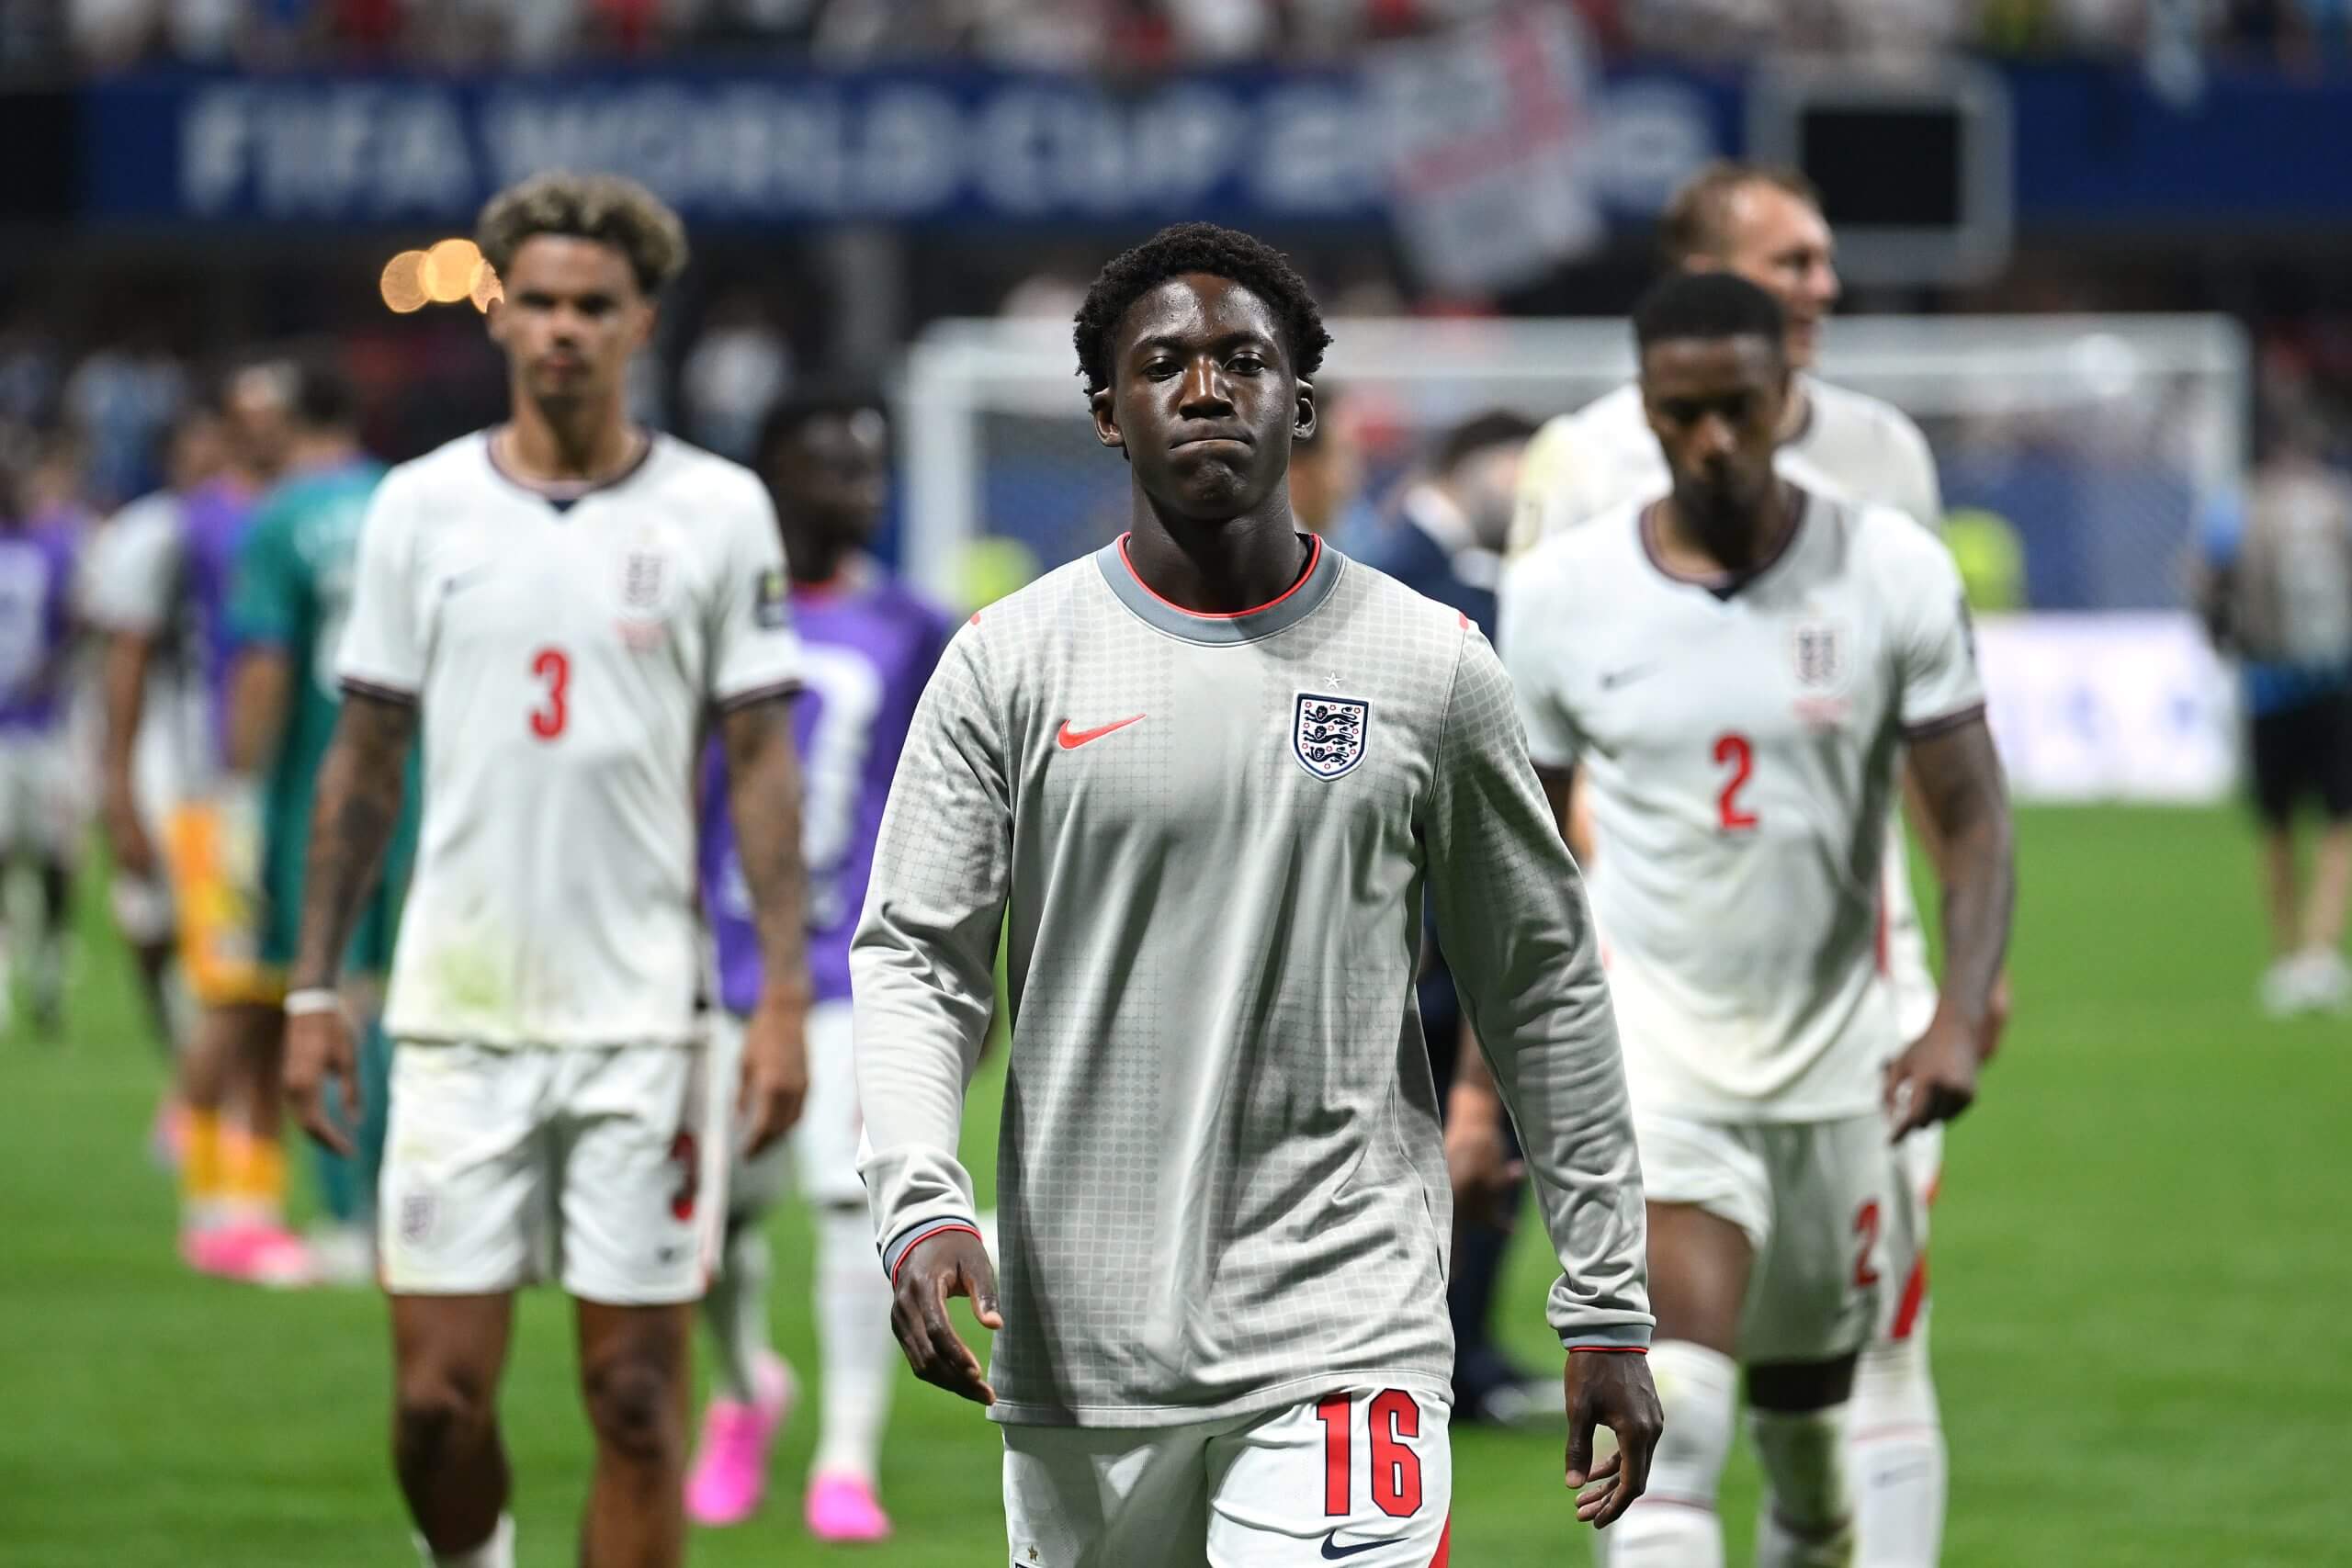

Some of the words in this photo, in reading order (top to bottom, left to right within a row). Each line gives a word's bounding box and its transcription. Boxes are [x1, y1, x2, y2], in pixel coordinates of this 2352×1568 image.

[179, 83, 475, 213] FIFA
[487, 83, 965, 217] WORLD
[977, 85, 1264, 217] CUP
[530, 649, 572, 742] 3
[1713, 731, 1758, 829] 2
[1854, 1200, 1882, 1288] 2
[1317, 1388, 1422, 1518] 16
